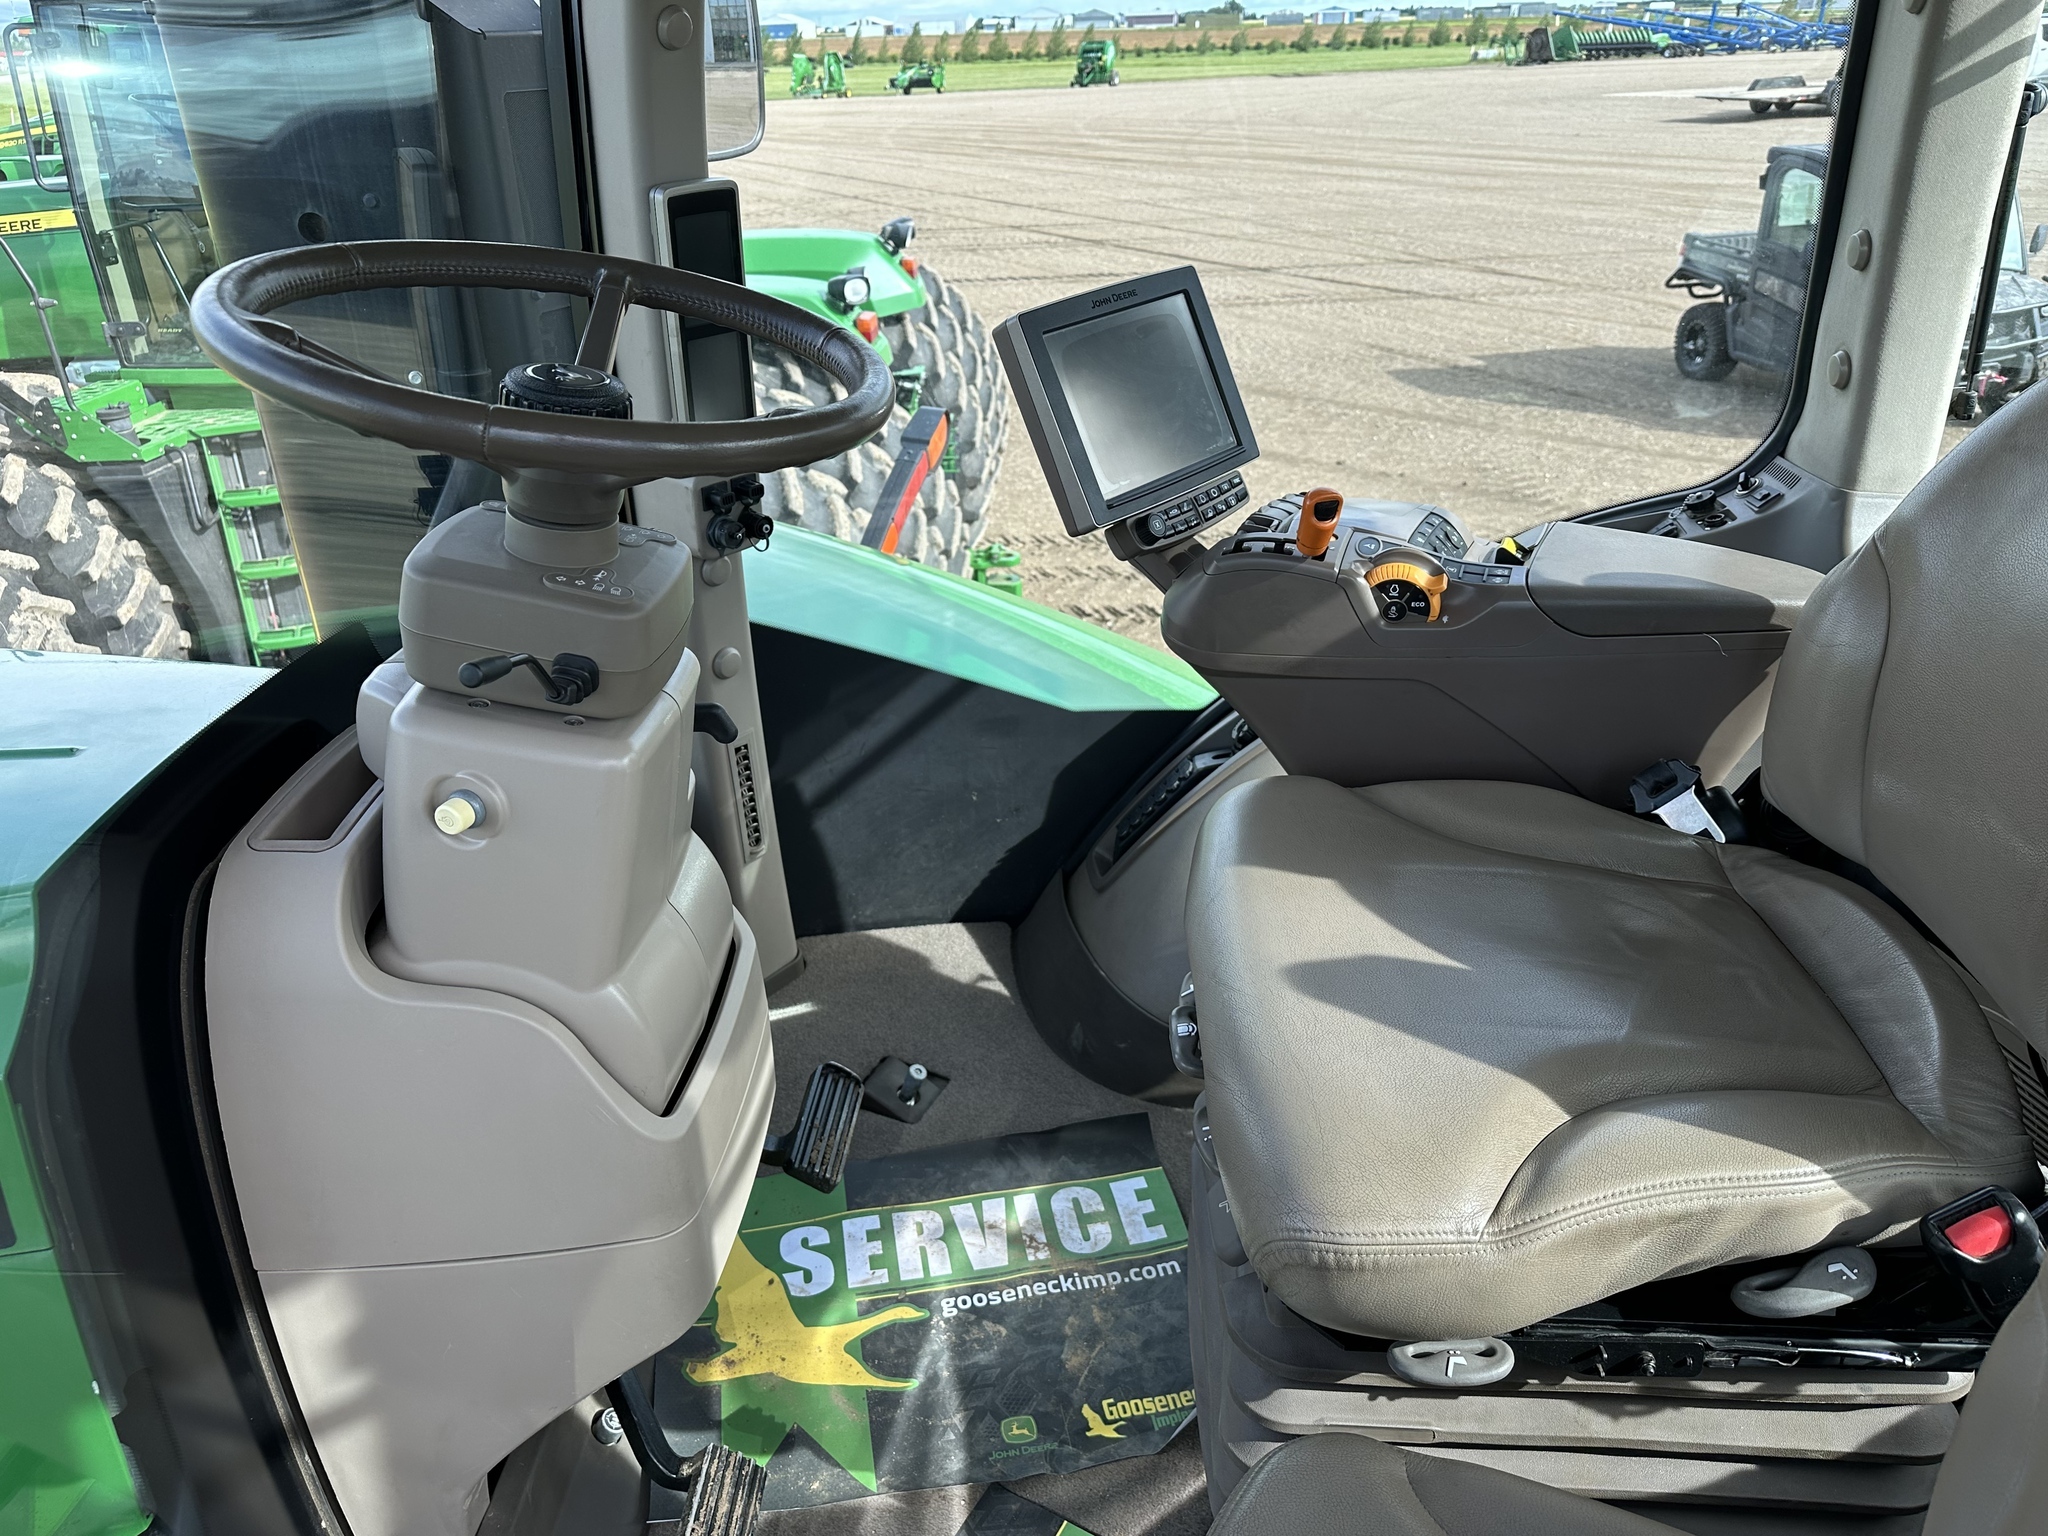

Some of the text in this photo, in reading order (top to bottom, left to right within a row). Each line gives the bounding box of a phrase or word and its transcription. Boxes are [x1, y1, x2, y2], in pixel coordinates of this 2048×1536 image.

[1091, 289, 1138, 309] JOHN DEERE
[779, 1175, 1168, 1297] SERVICE
[940, 1258, 1182, 1318] gooseneckimp.com
[989, 1448, 1020, 1460] JOHN
